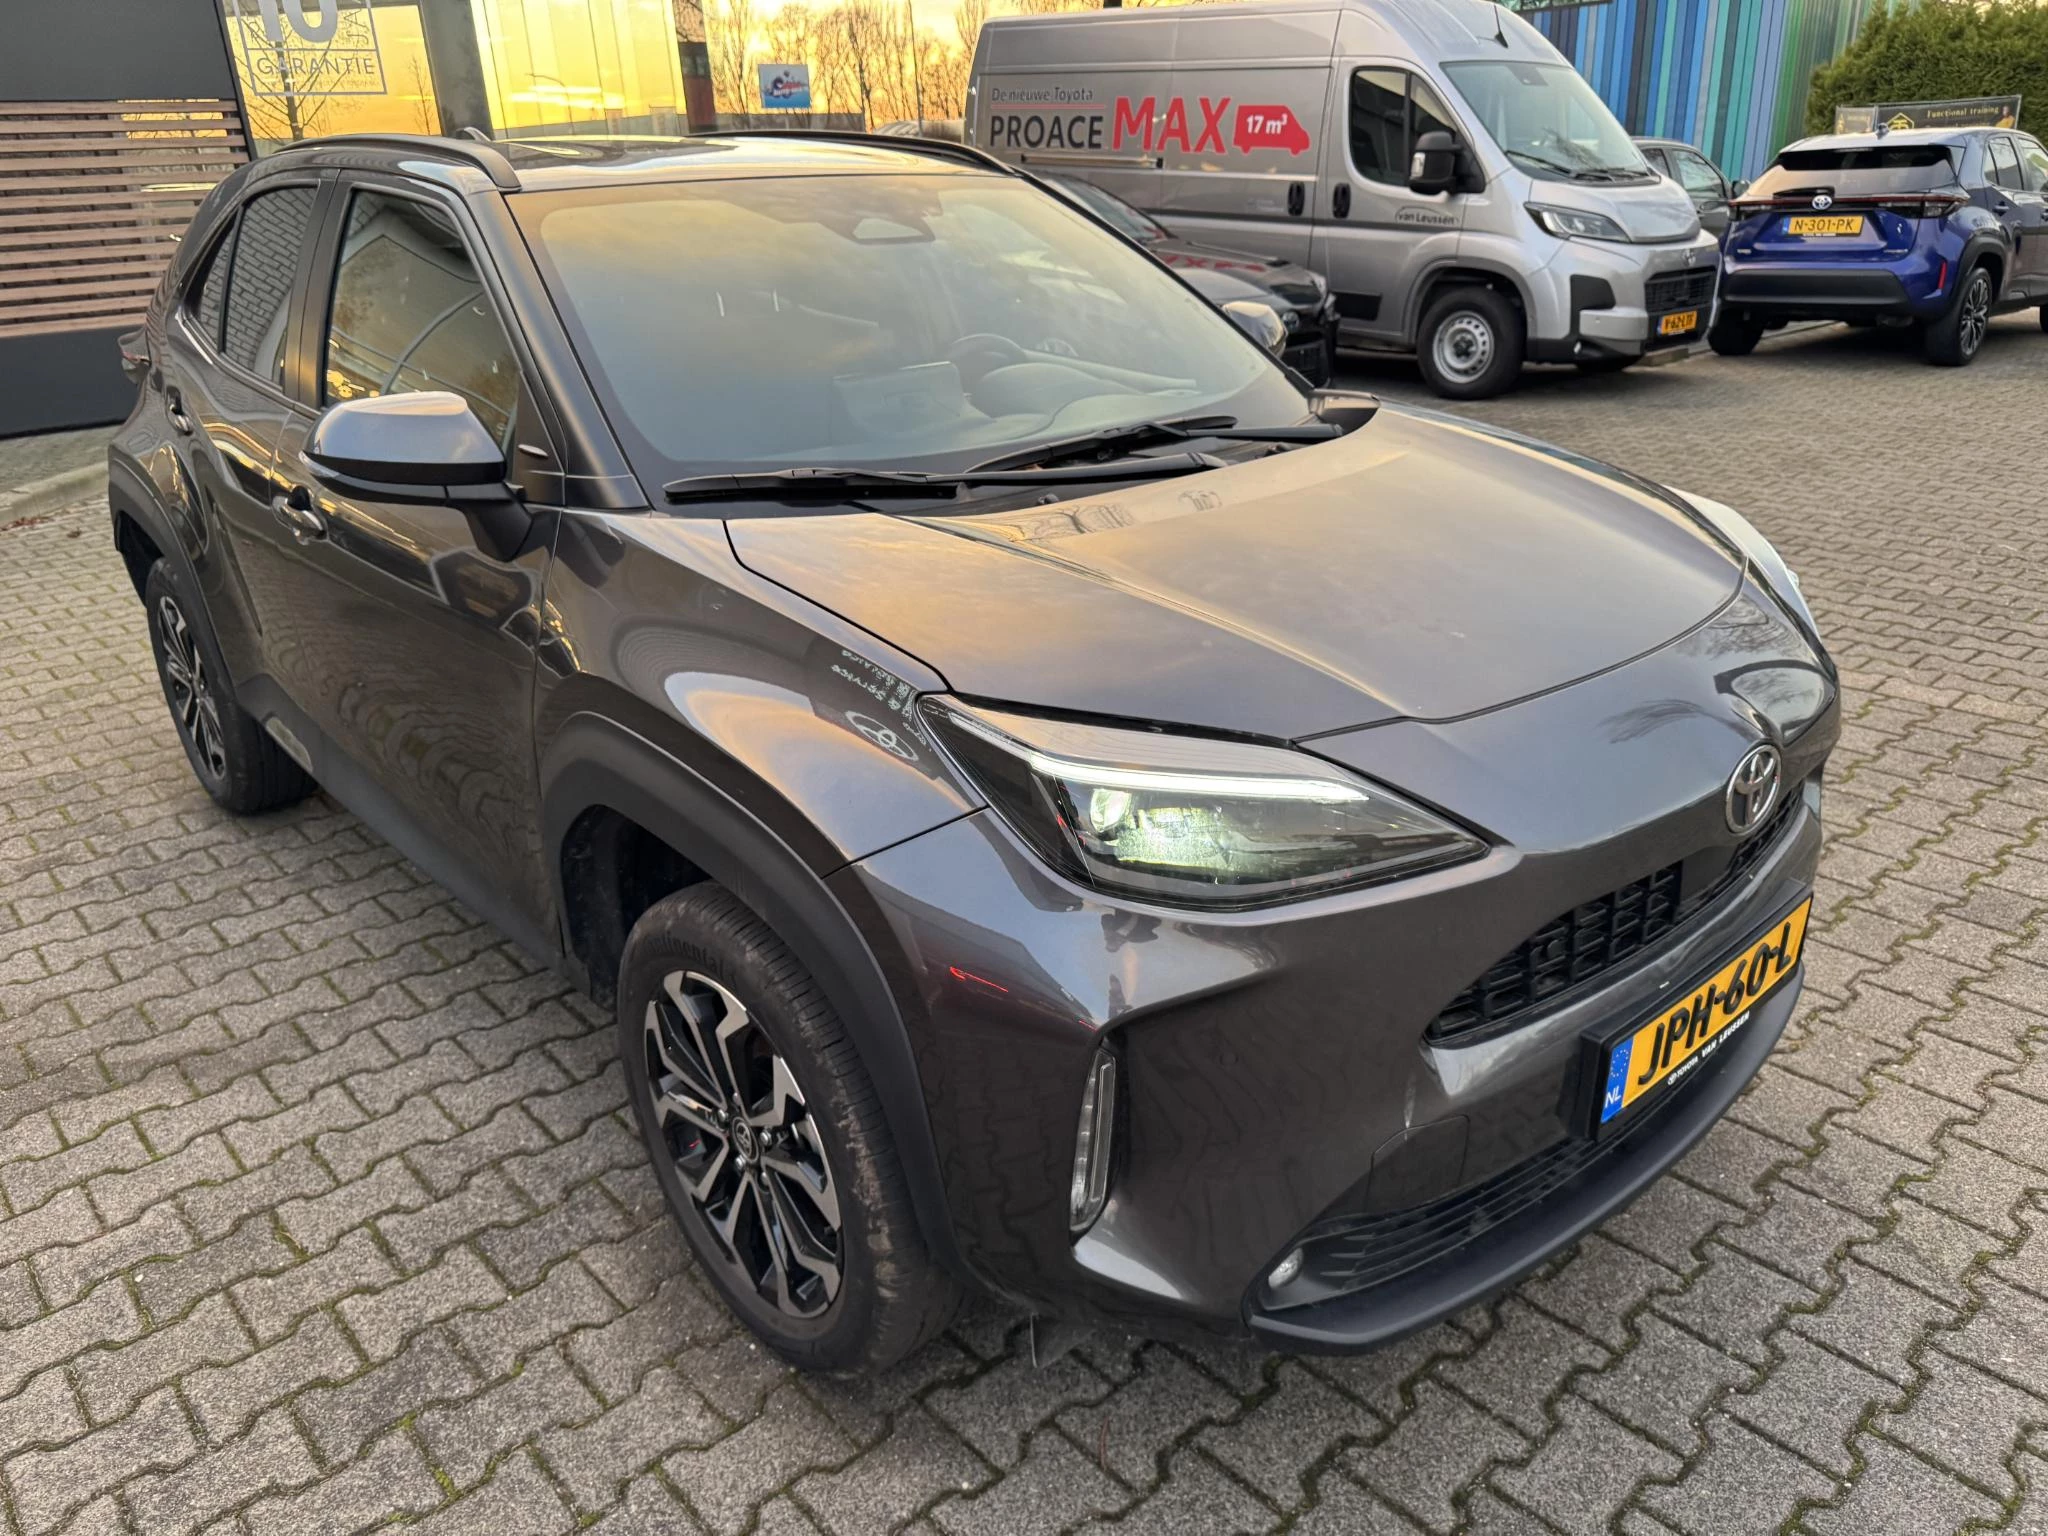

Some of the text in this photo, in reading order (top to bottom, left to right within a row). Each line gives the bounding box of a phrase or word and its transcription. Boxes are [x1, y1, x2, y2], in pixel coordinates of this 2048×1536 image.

[344, 0, 370, 45] JA
[257, 57, 375, 75] GARANTIE
[992, 87, 1093, 104] De nieuwe Toyota
[1927, 107, 1967, 119] Functional
[990, 96, 1231, 154] PROACE MAX
[1794, 218, 1854, 231] N-301-PK
[1638, 922, 1791, 1085] JPH-60-L
[1719, 1010, 1750, 1043] LEUSSEN
[1604, 1086, 1622, 1108] NL
